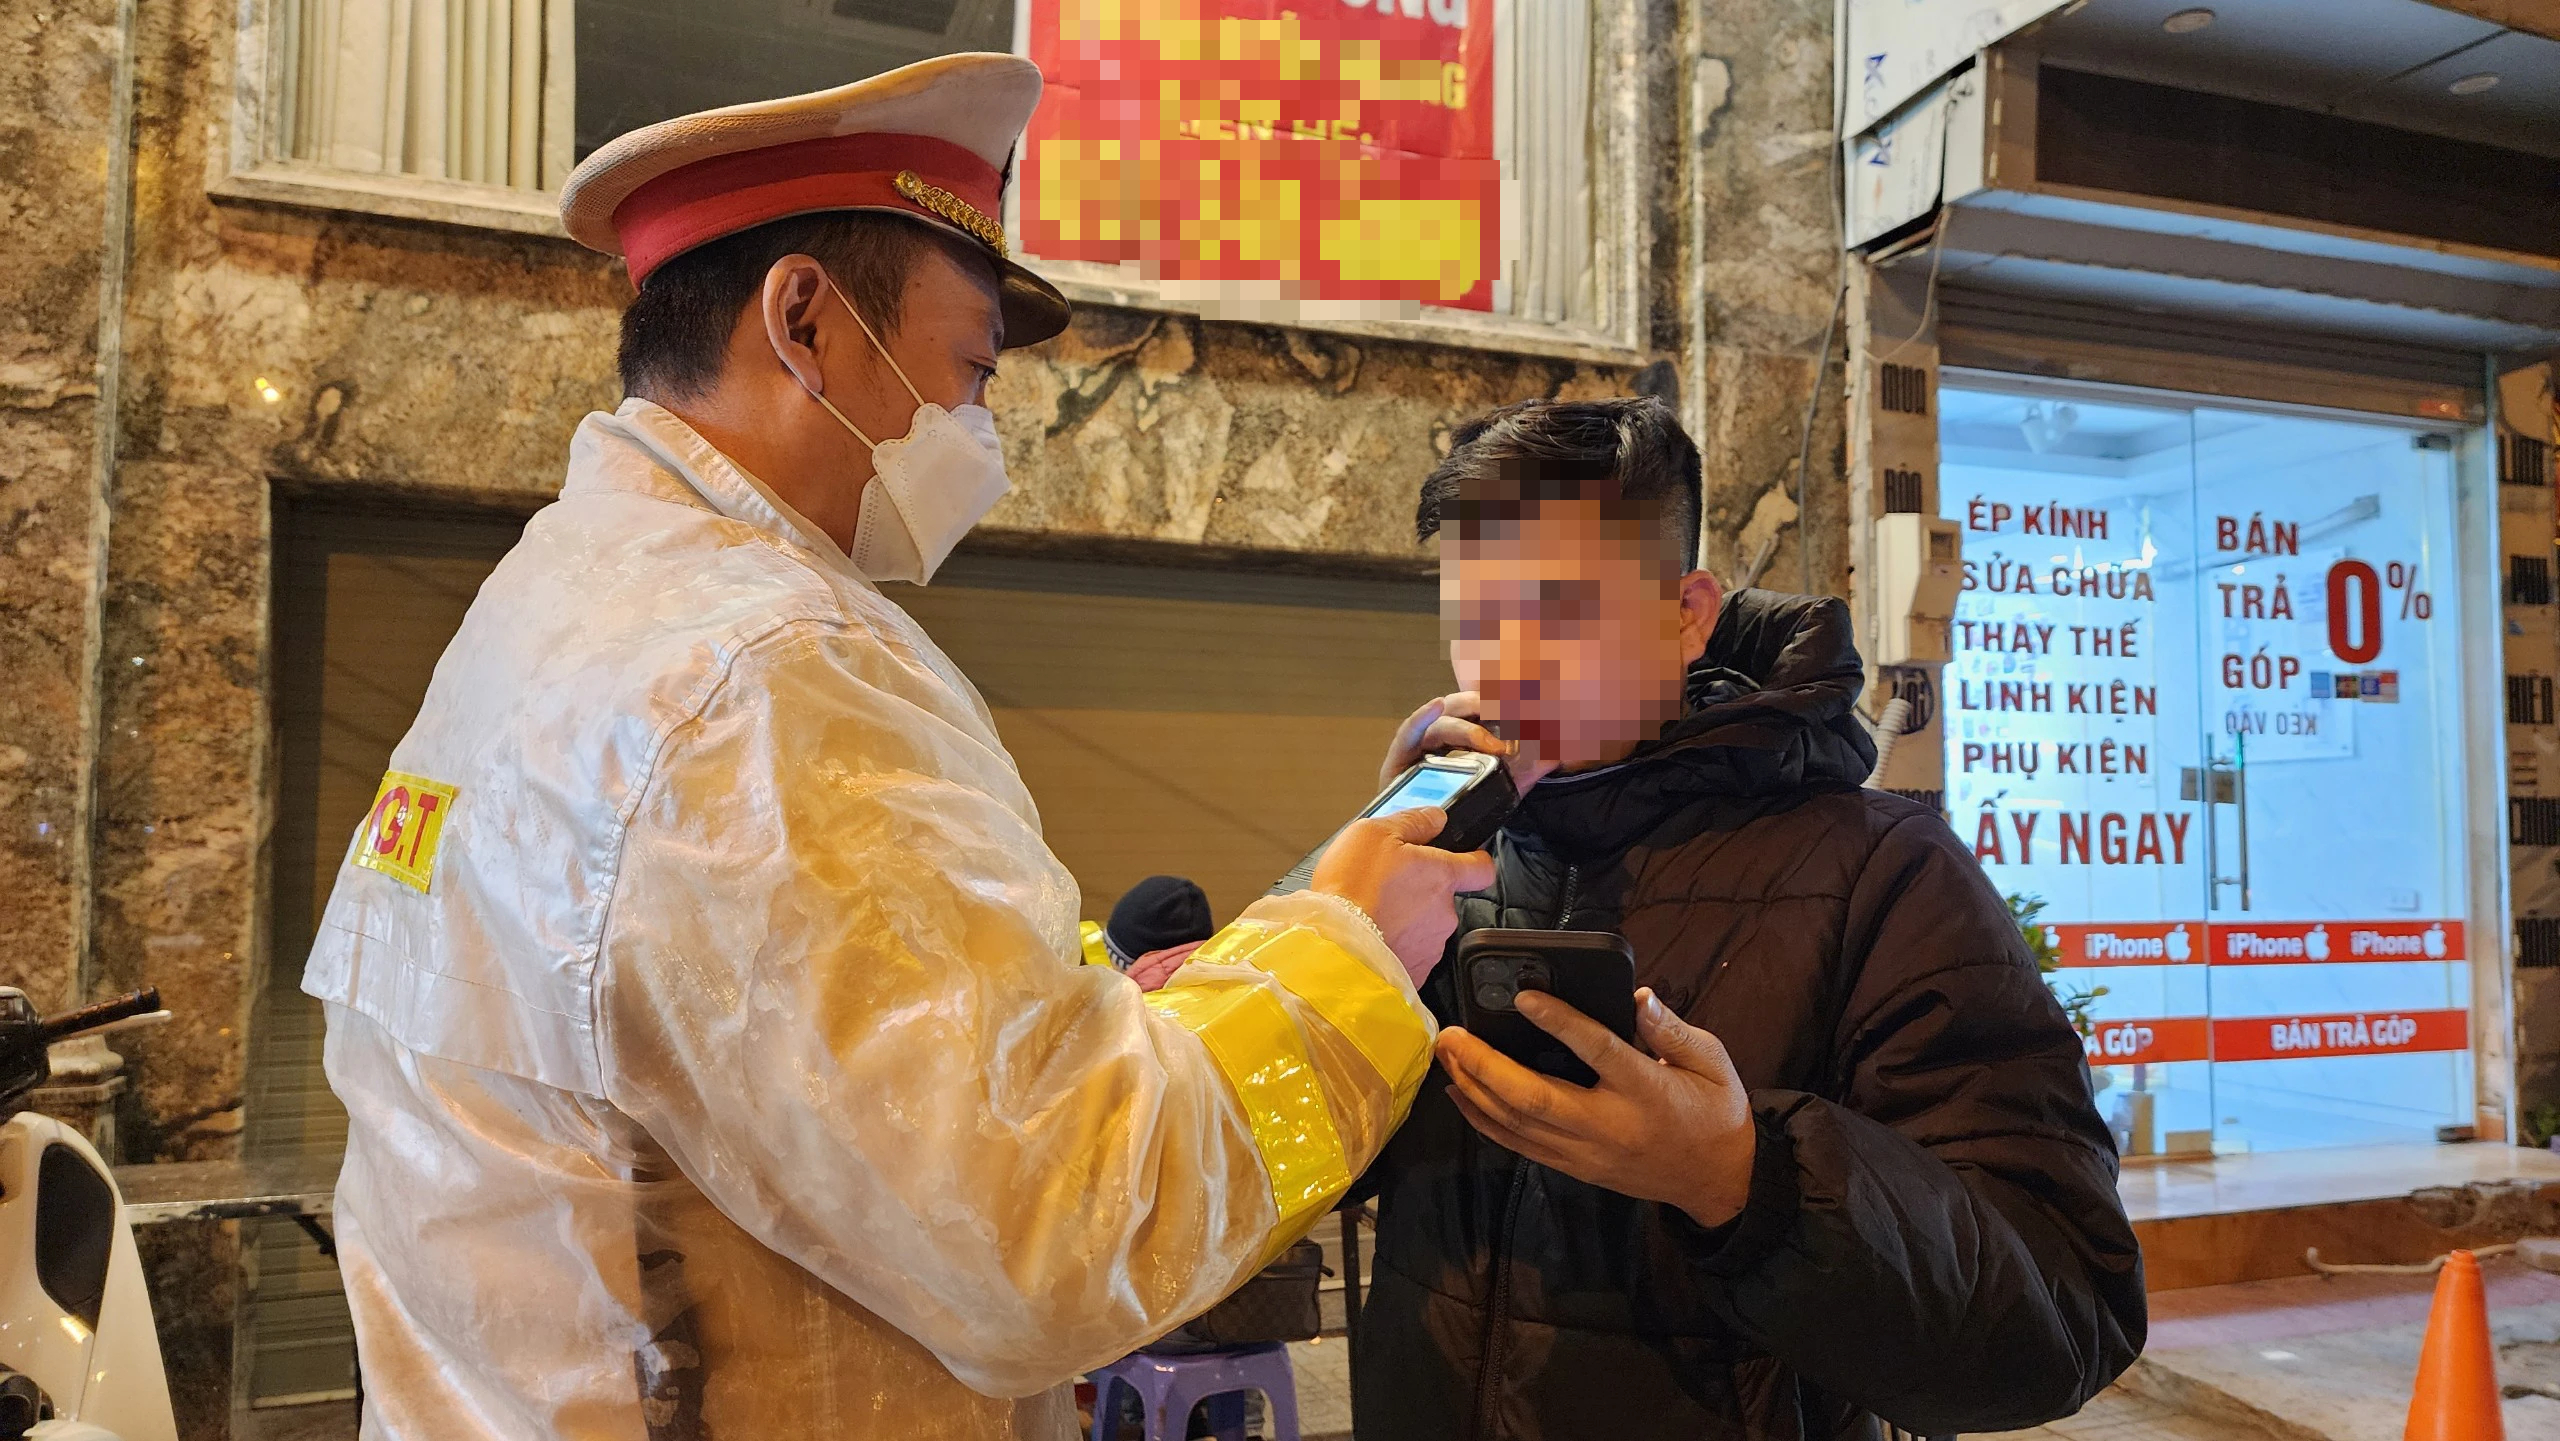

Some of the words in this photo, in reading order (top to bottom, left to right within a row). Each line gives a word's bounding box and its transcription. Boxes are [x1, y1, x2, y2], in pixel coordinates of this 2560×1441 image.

[1968, 494, 2012, 532] ÉP
[2023, 500, 2107, 540] KÍNH
[2217, 511, 2299, 556] BÁN
[1962, 551, 2036, 594] SỬA
[2217, 574, 2294, 620] TRẢ
[1958, 620, 2055, 654] THAY
[2069, 617, 2142, 657] THẾ
[2222, 641, 2300, 689] GÓP
[1960, 679, 2052, 713] LINH
[2068, 677, 2156, 723] KIỆN
[1963, 741, 2039, 779] PHỤ
[2057, 738, 2147, 781] KIỆN
[1974, 789, 2039, 865] ẤY
[2059, 811, 2191, 865] NGAY
[2085, 932, 2164, 959] iPhone
[2227, 932, 2304, 958] iPhone
[2350, 930, 2422, 956] iPhone
[2104, 1022, 2154, 1057] GÓP
[2271, 1019, 2321, 1051] BÁN
[2322, 1013, 2370, 1048] TRẢ
[2371, 1015, 2417, 1046] GÓP
